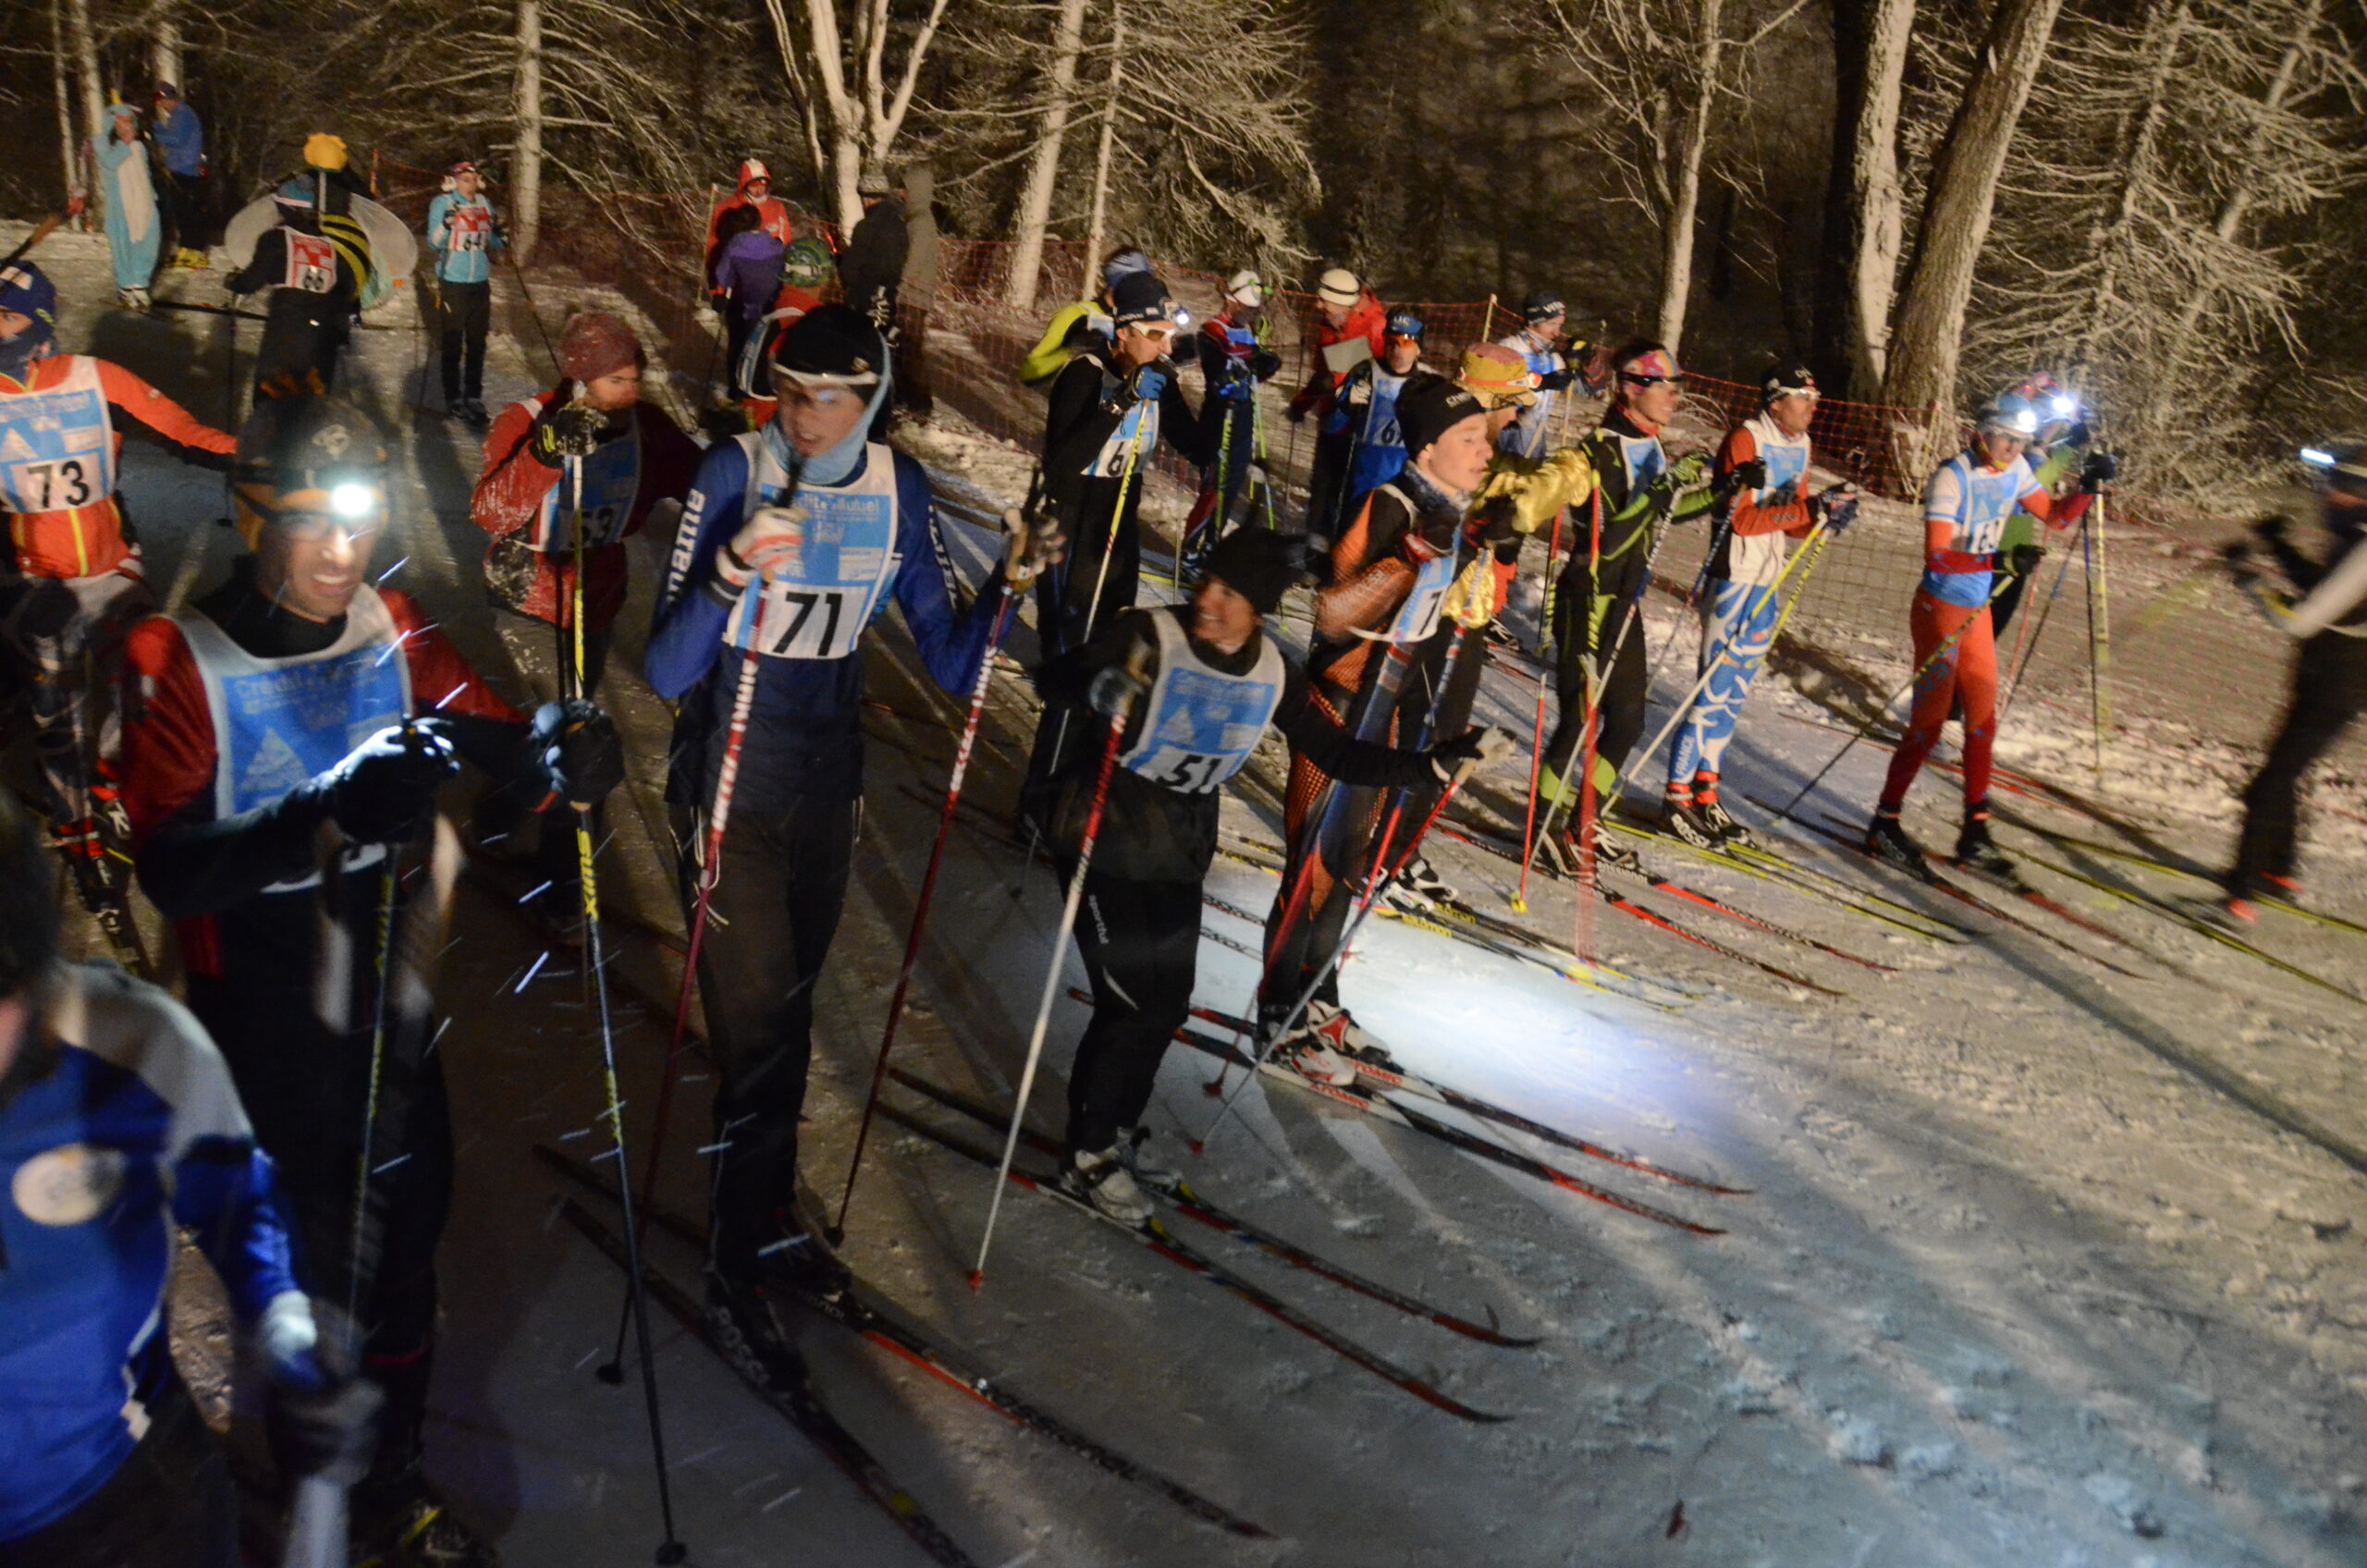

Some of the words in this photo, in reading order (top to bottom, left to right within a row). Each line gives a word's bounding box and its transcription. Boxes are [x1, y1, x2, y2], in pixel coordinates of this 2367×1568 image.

[1381, 420, 1404, 444] 6
[26, 460, 90, 508] 73
[773, 591, 843, 656] 71
[1156, 753, 1222, 788] 51
[1674, 734, 1696, 777] FRANCE
